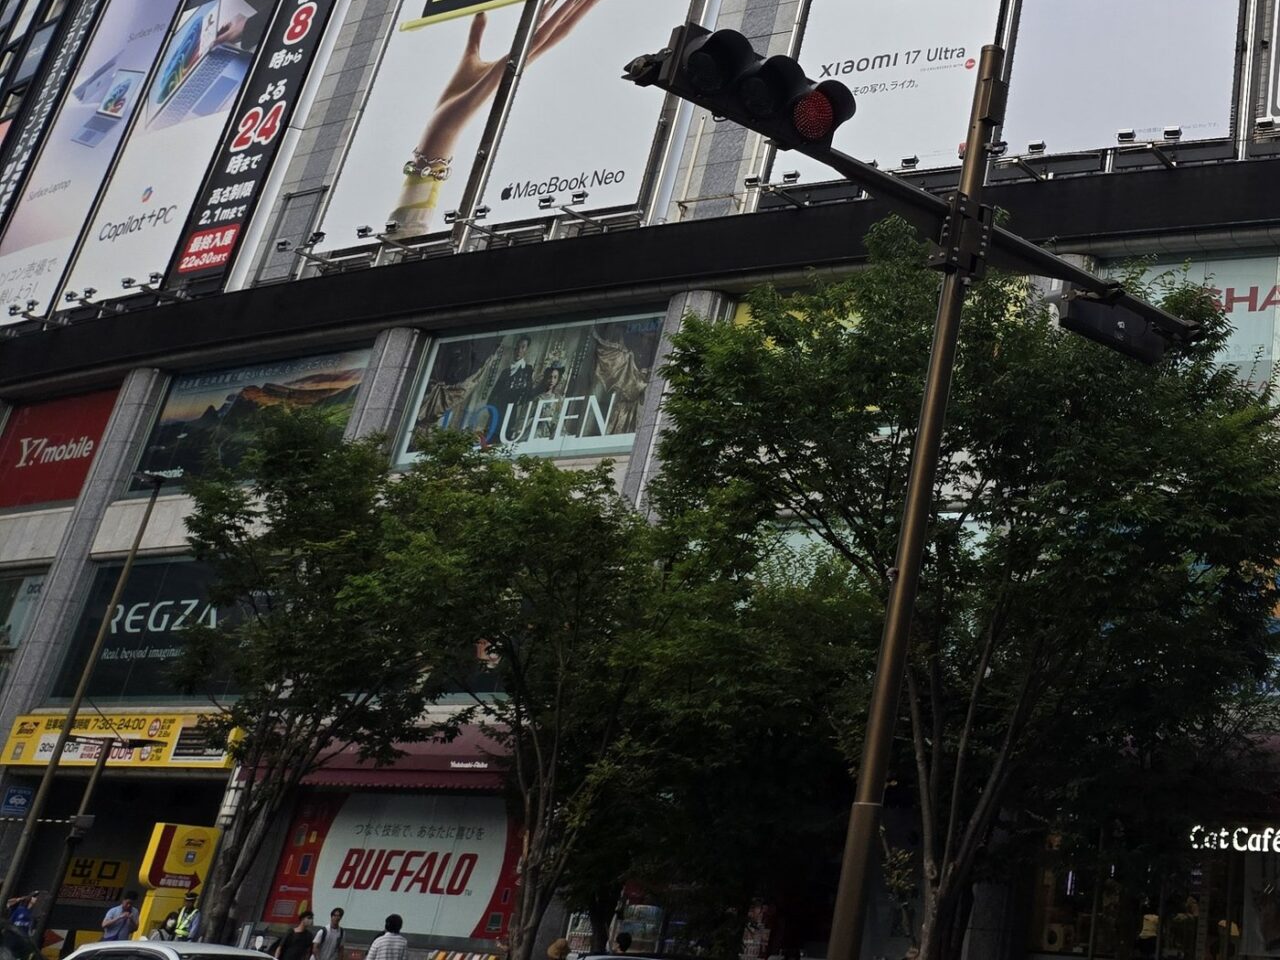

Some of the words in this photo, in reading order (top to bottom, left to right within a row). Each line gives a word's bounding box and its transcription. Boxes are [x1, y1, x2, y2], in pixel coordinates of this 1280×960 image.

[283, 2, 317, 46] 8
[269, 49, 303, 69] 時から
[904, 50, 922, 65] 17
[926, 46, 966, 62] Ultra
[258, 78, 287, 103] よる
[229, 100, 286, 152] 24
[226, 154, 263, 174] 時まで
[207, 180, 255, 206] 高さ制限
[512, 172, 589, 199] MacBook
[590, 169, 625, 188] Neo
[188, 229, 236, 253] 最終入庫
[71, 858, 121, 880] 出口
[333, 848, 479, 896] BUFFALO
